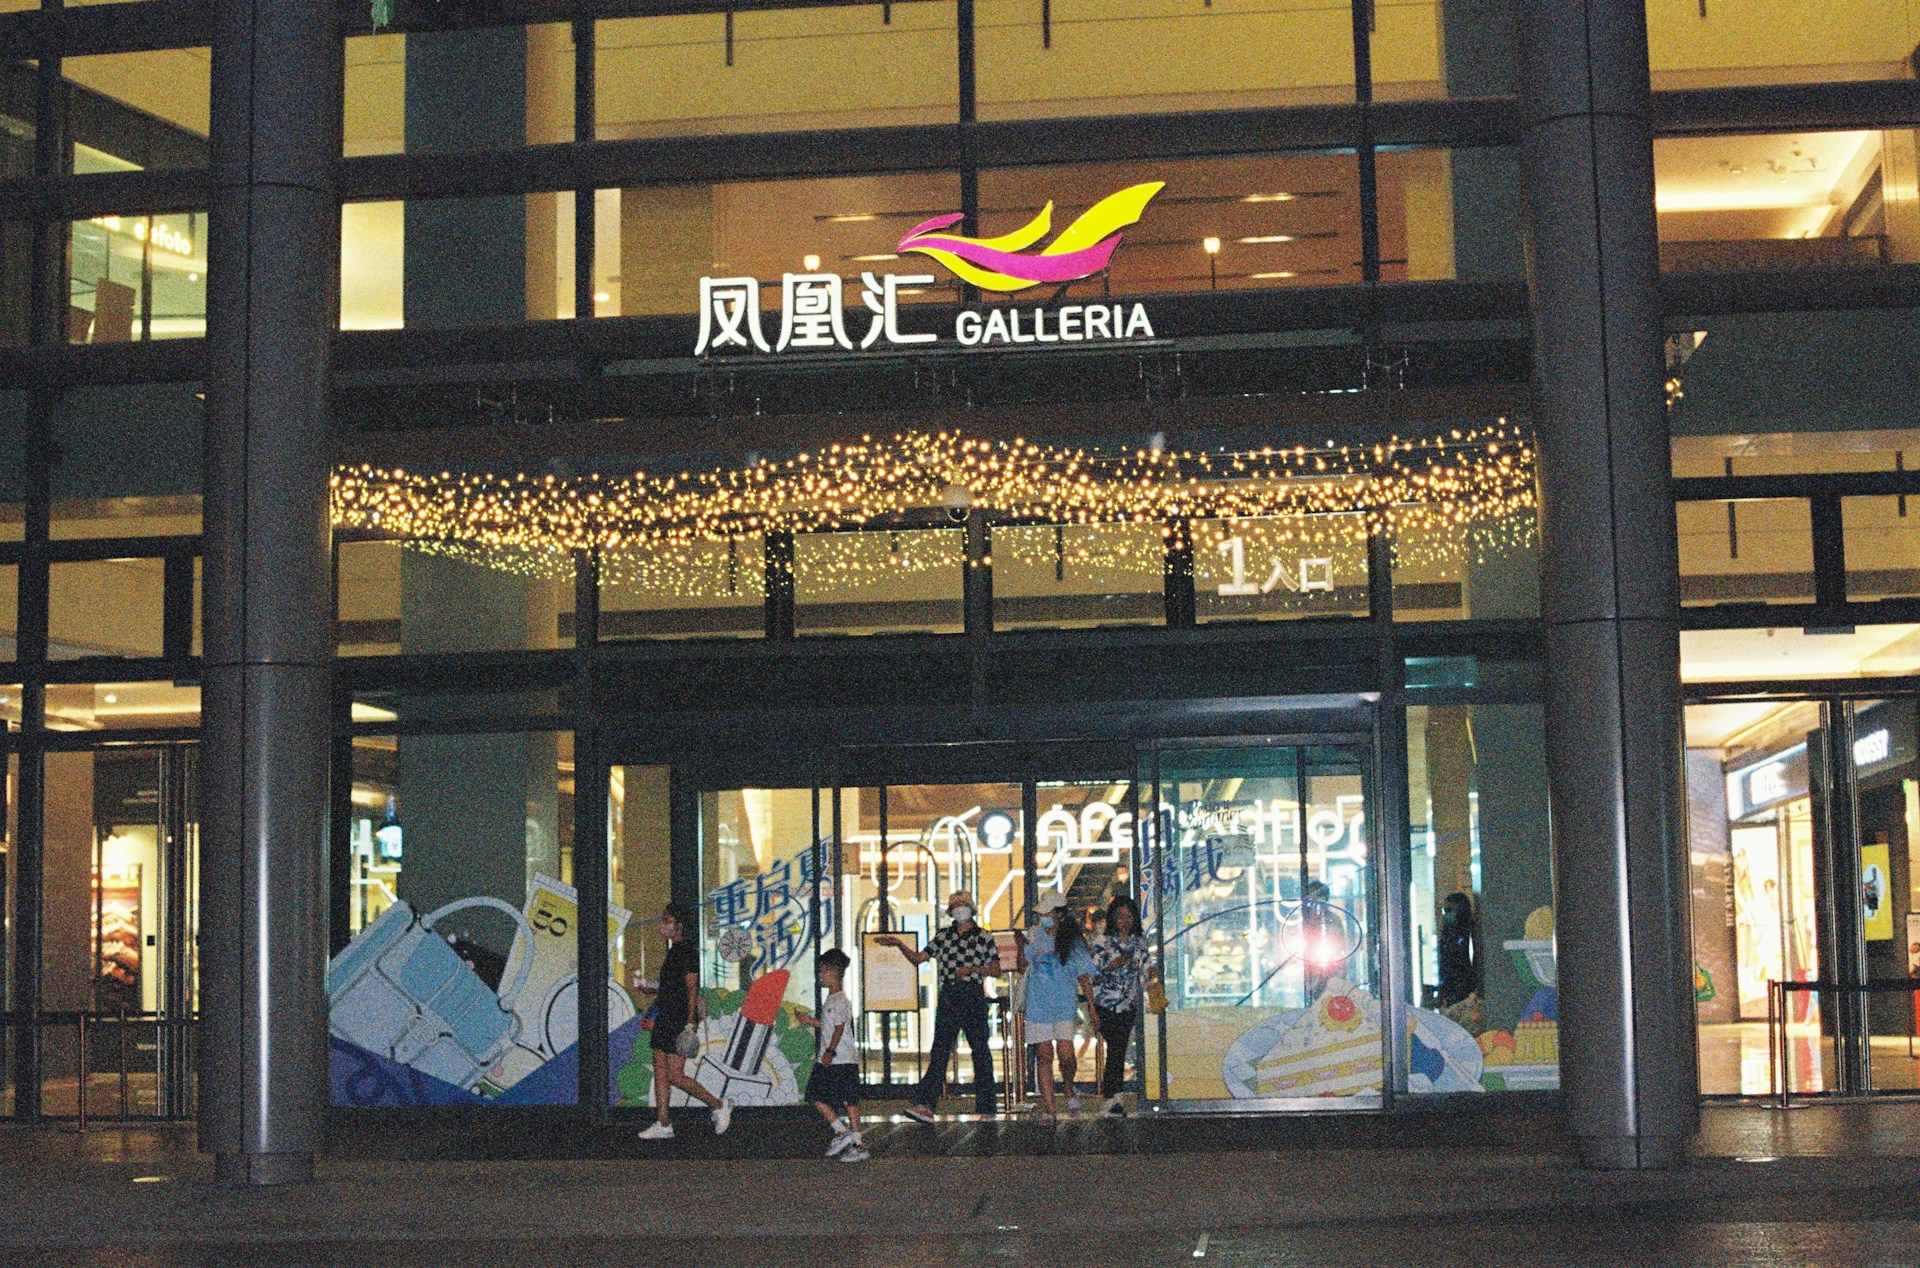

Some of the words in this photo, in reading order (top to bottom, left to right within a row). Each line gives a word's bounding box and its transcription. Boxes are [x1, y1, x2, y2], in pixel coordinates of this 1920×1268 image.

[694, 271, 938, 356] 凤凰汇
[955, 302, 1155, 346] GALLERIA
